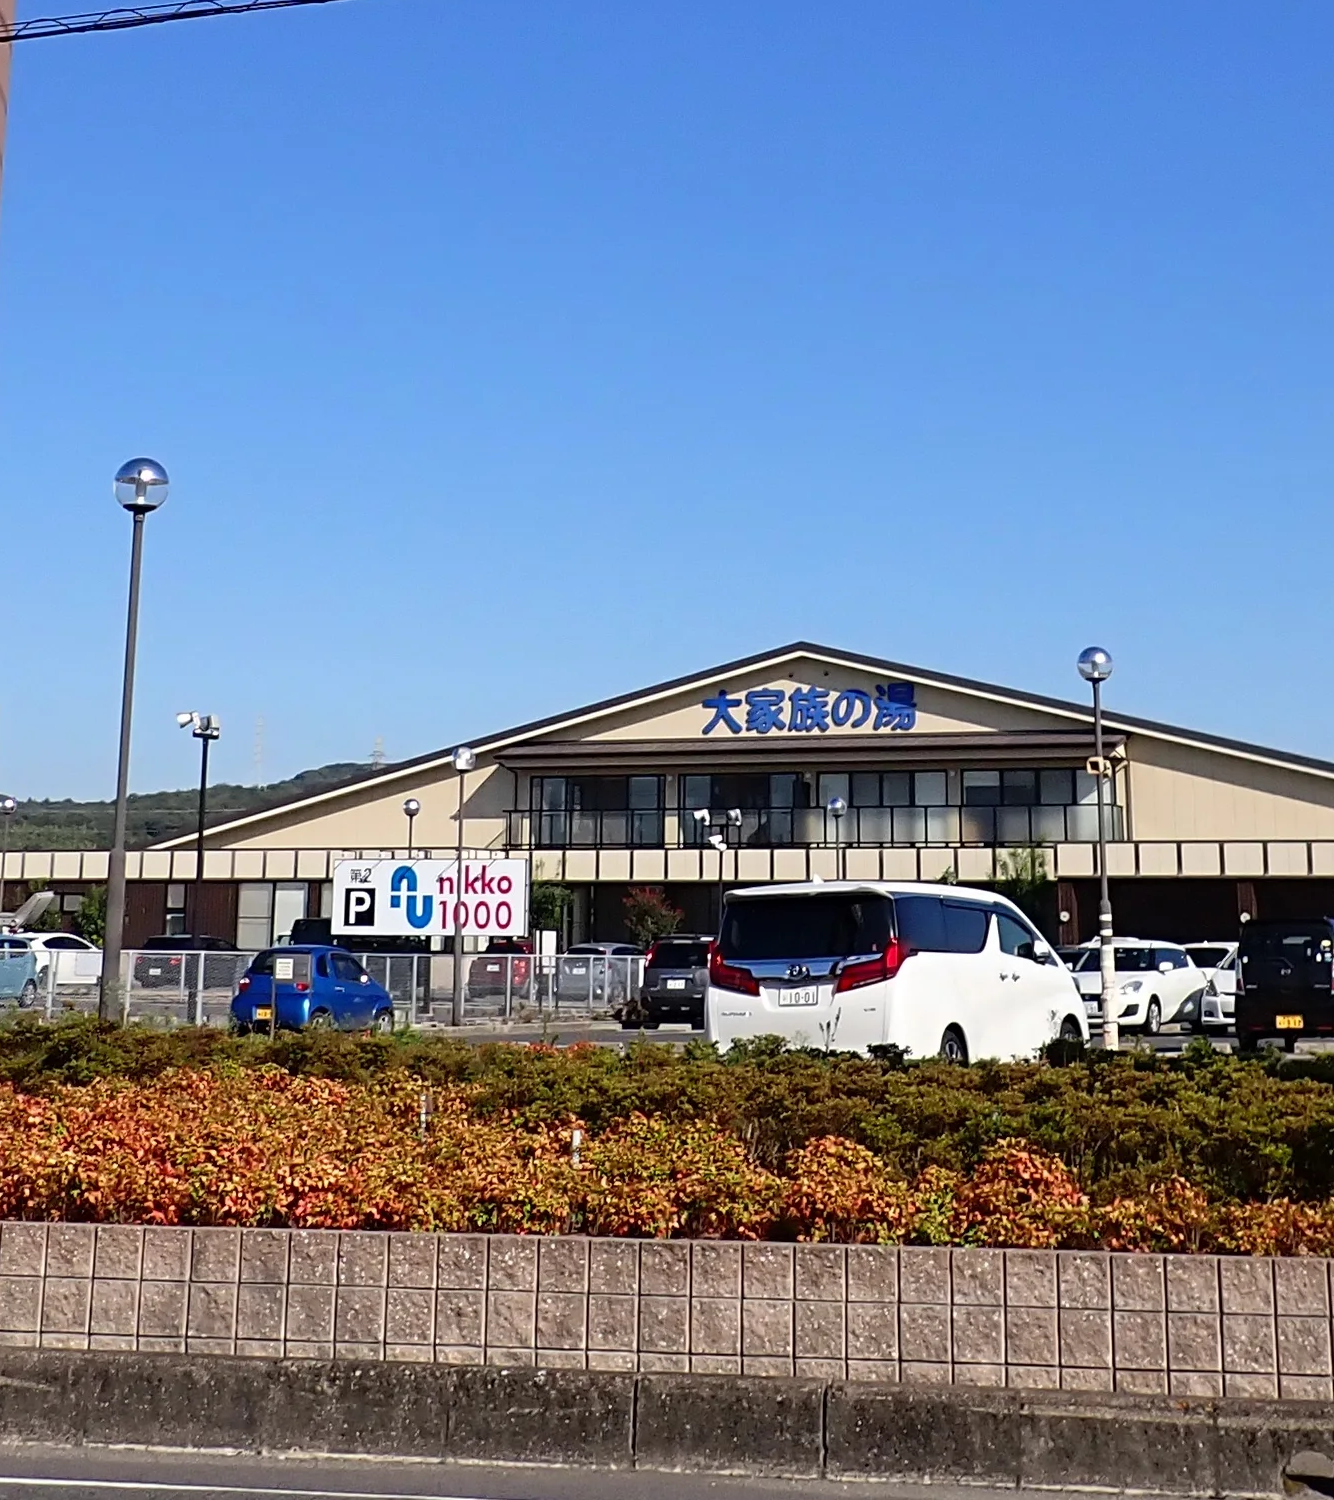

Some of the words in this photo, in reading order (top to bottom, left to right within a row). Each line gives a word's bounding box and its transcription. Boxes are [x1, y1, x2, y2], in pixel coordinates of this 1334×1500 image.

[702, 682, 917, 735] 大家族の湯
[438, 865, 513, 895] nkko
[438, 901, 513, 930] 1000
